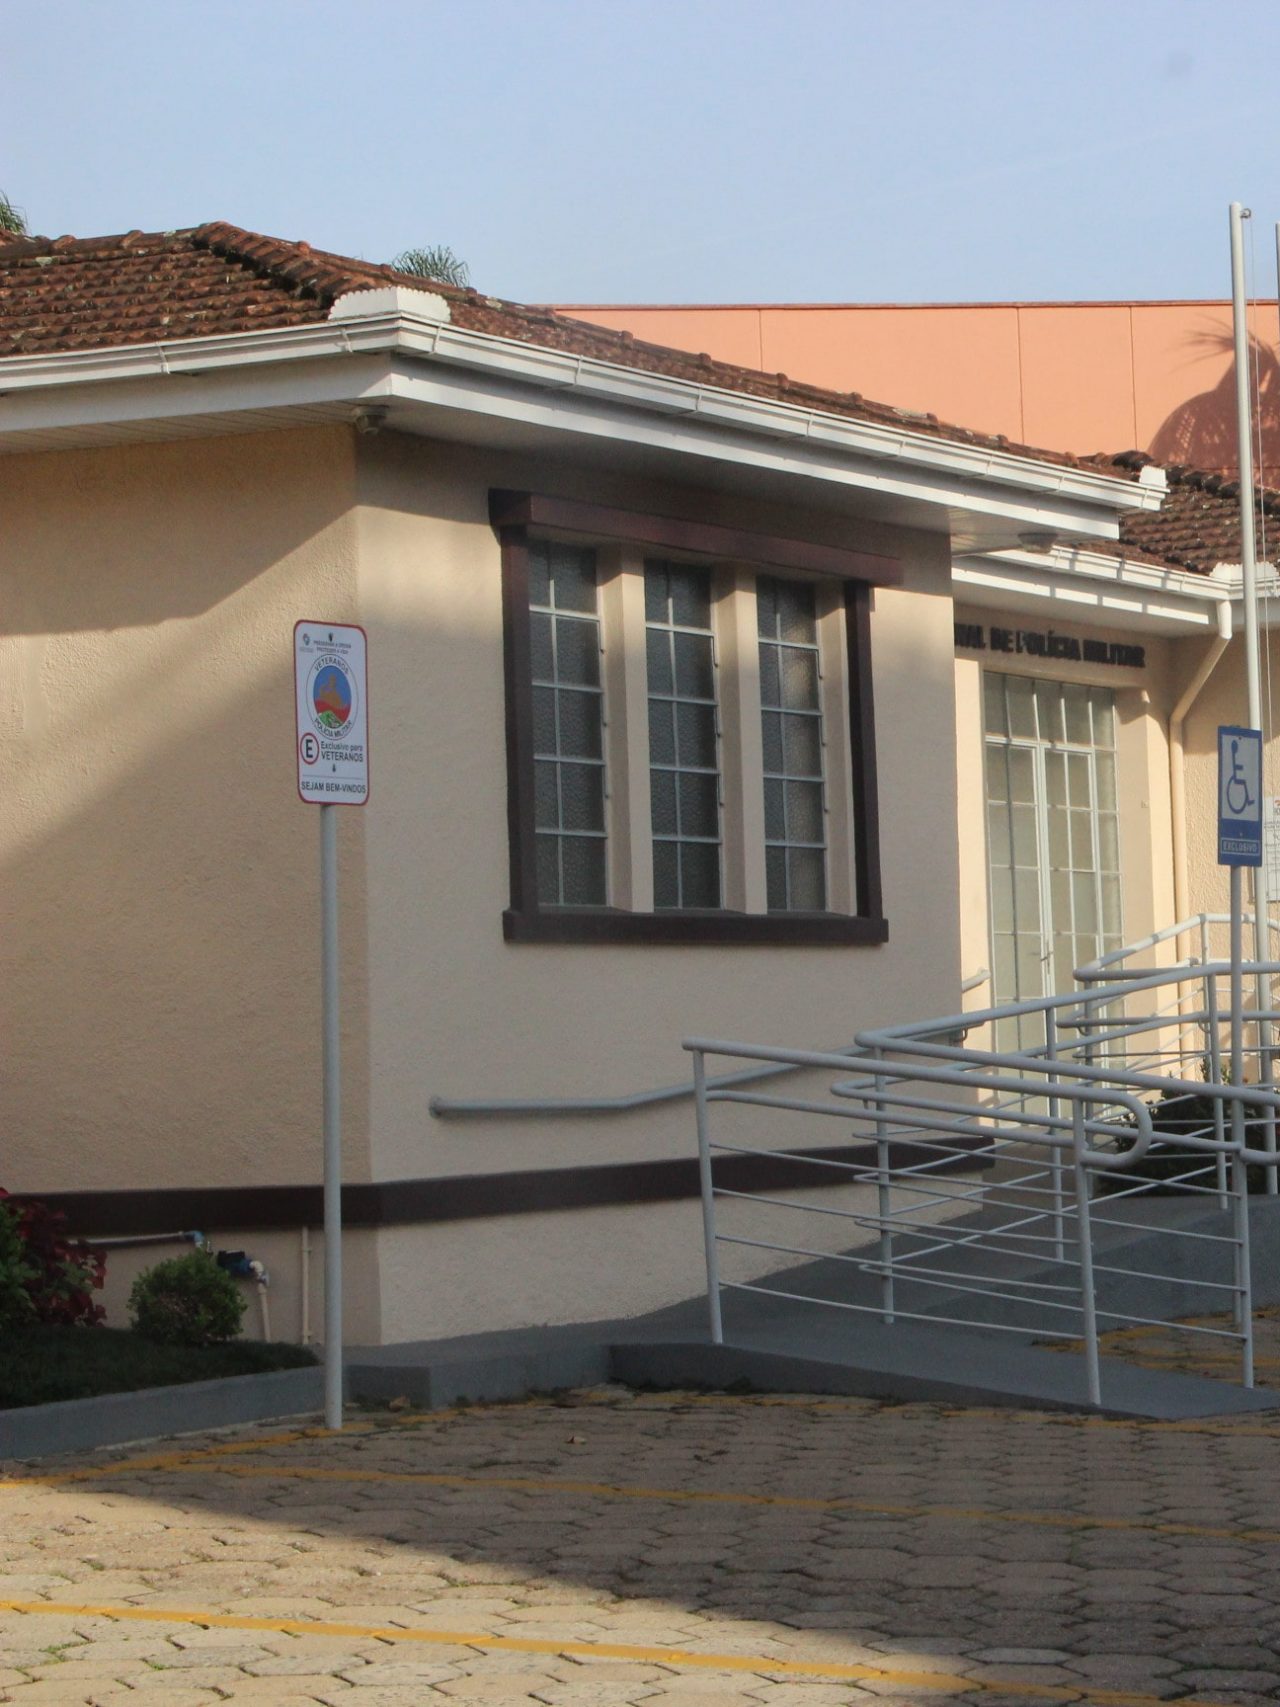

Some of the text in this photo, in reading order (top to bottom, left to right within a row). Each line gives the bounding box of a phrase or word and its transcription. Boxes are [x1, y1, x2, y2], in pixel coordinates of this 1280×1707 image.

[315, 656, 349, 675] VETERANOS
[305, 739, 314, 759] E
[321, 741, 350, 752] Exclusivo
[321, 751, 364, 762] VETERANOS
[301, 781, 366, 794] SEJAM BEM-VINDOS
